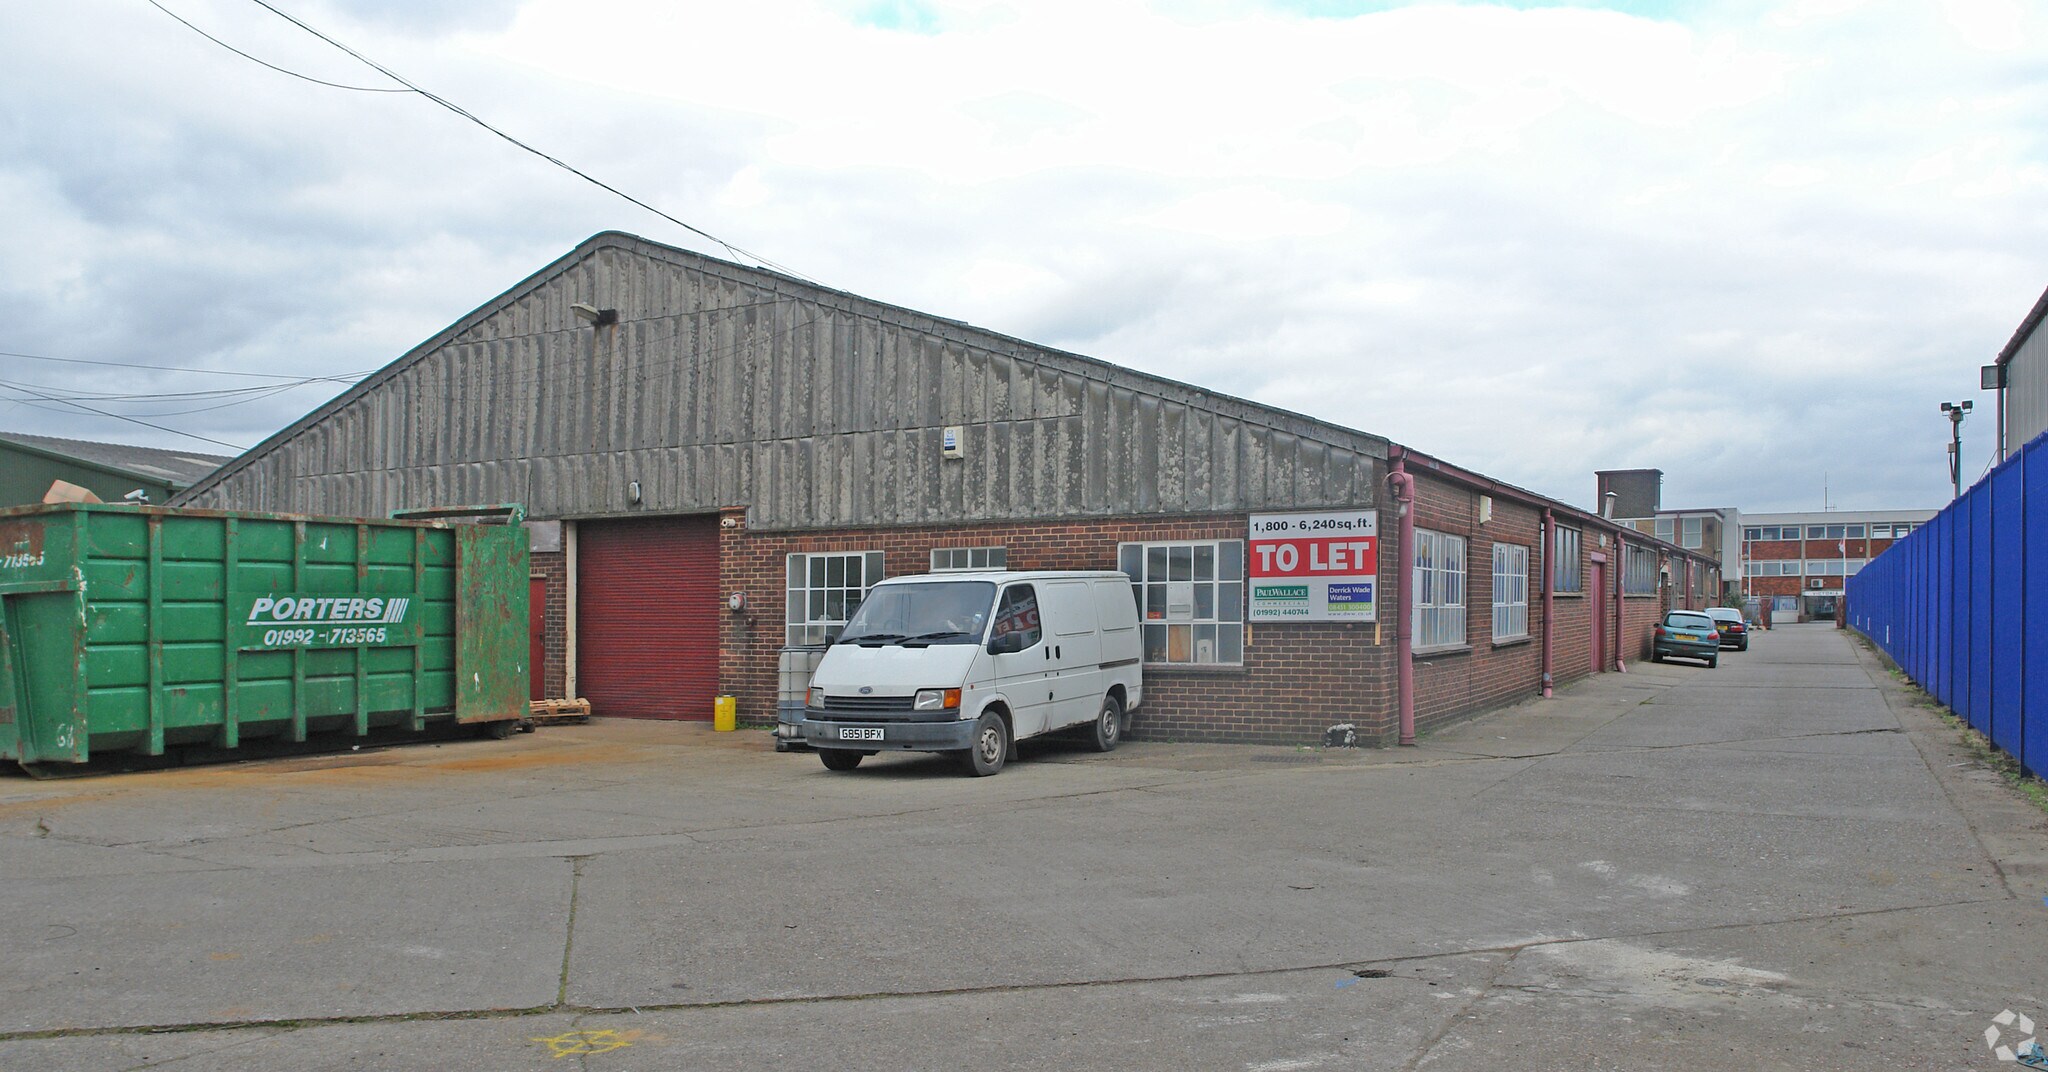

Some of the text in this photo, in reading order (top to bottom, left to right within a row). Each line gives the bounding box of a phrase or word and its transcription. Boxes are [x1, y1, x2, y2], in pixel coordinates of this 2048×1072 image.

[1254, 521, 1288, 533] 1,800
[1256, 541, 1370, 572] TO LET
[248, 597, 385, 621] PORTERS
[1253, 608, 1309, 617] (01992) 440744
[842, 729, 882, 739] G851 BFX
